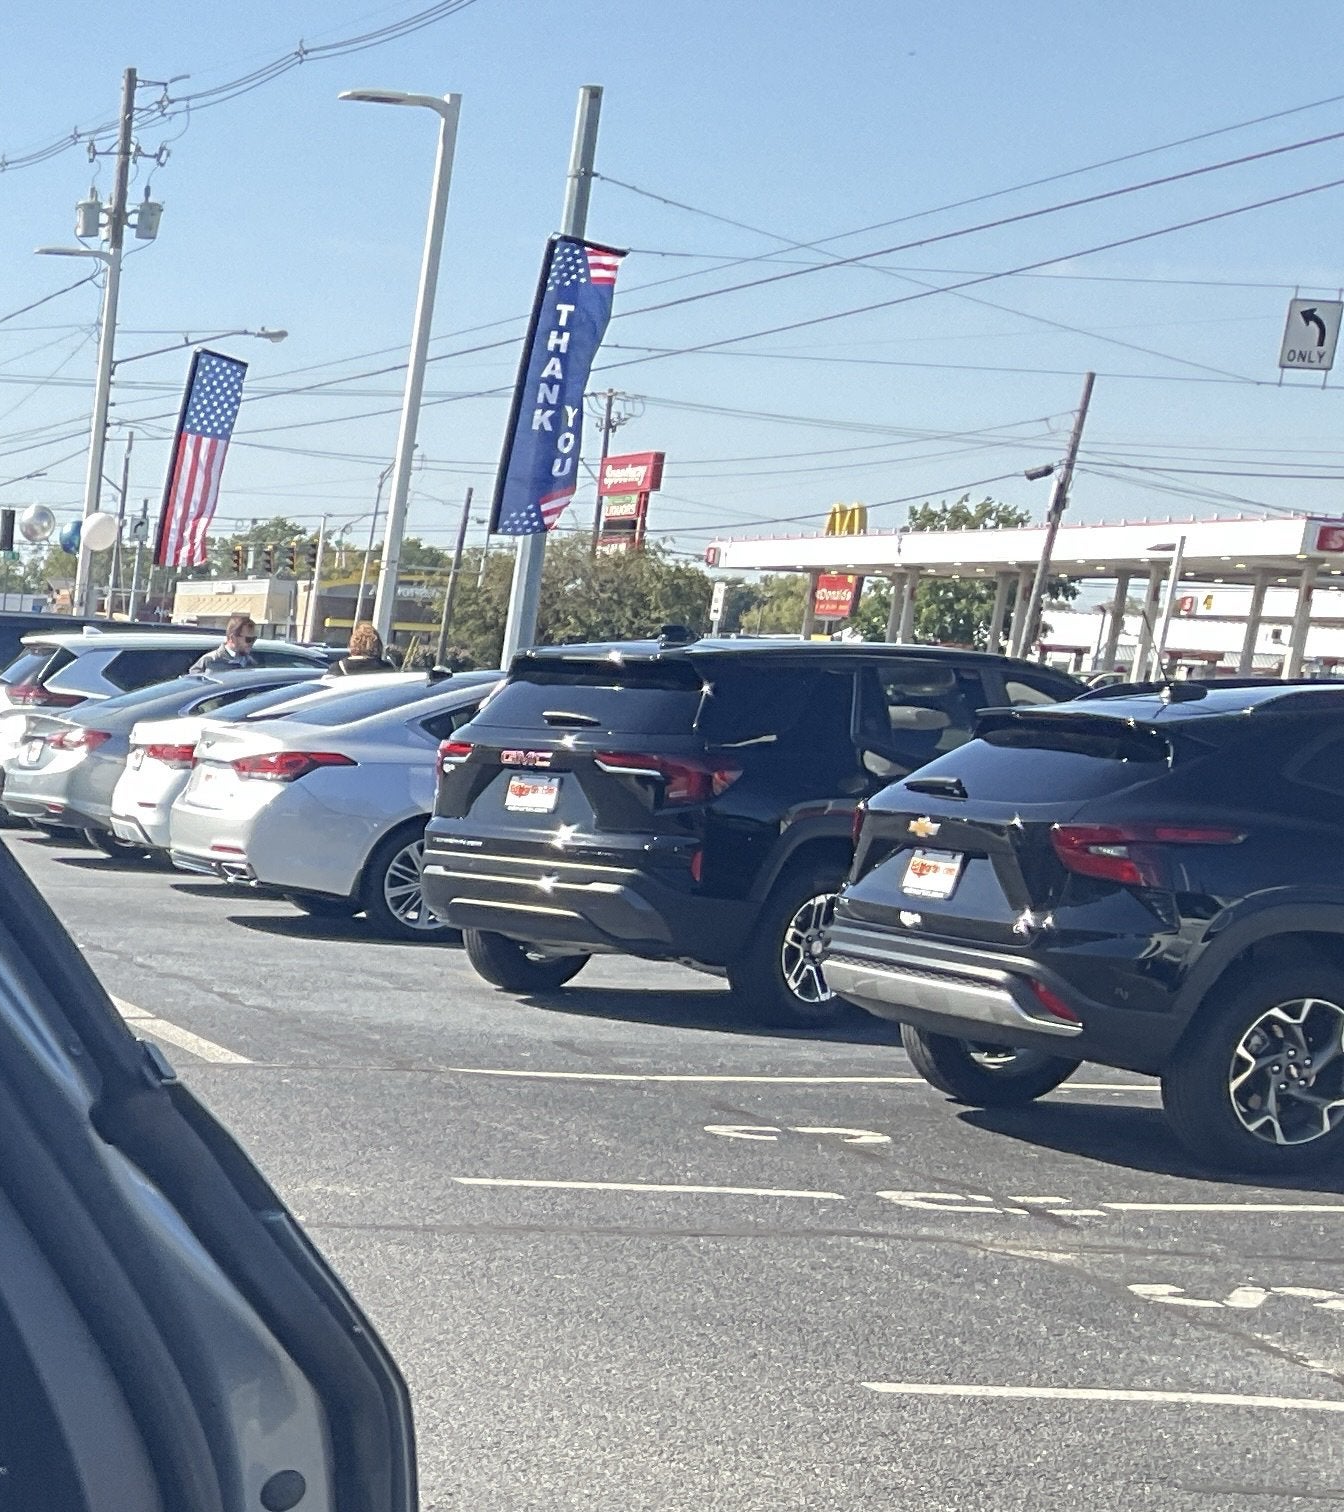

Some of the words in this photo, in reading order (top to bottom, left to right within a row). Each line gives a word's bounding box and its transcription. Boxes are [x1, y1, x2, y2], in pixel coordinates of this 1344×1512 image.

[532, 304, 575, 432] THANK
[1286, 349, 1326, 364] ONLY
[551, 405, 579, 478] YOU
[500, 750, 553, 767] GMC
